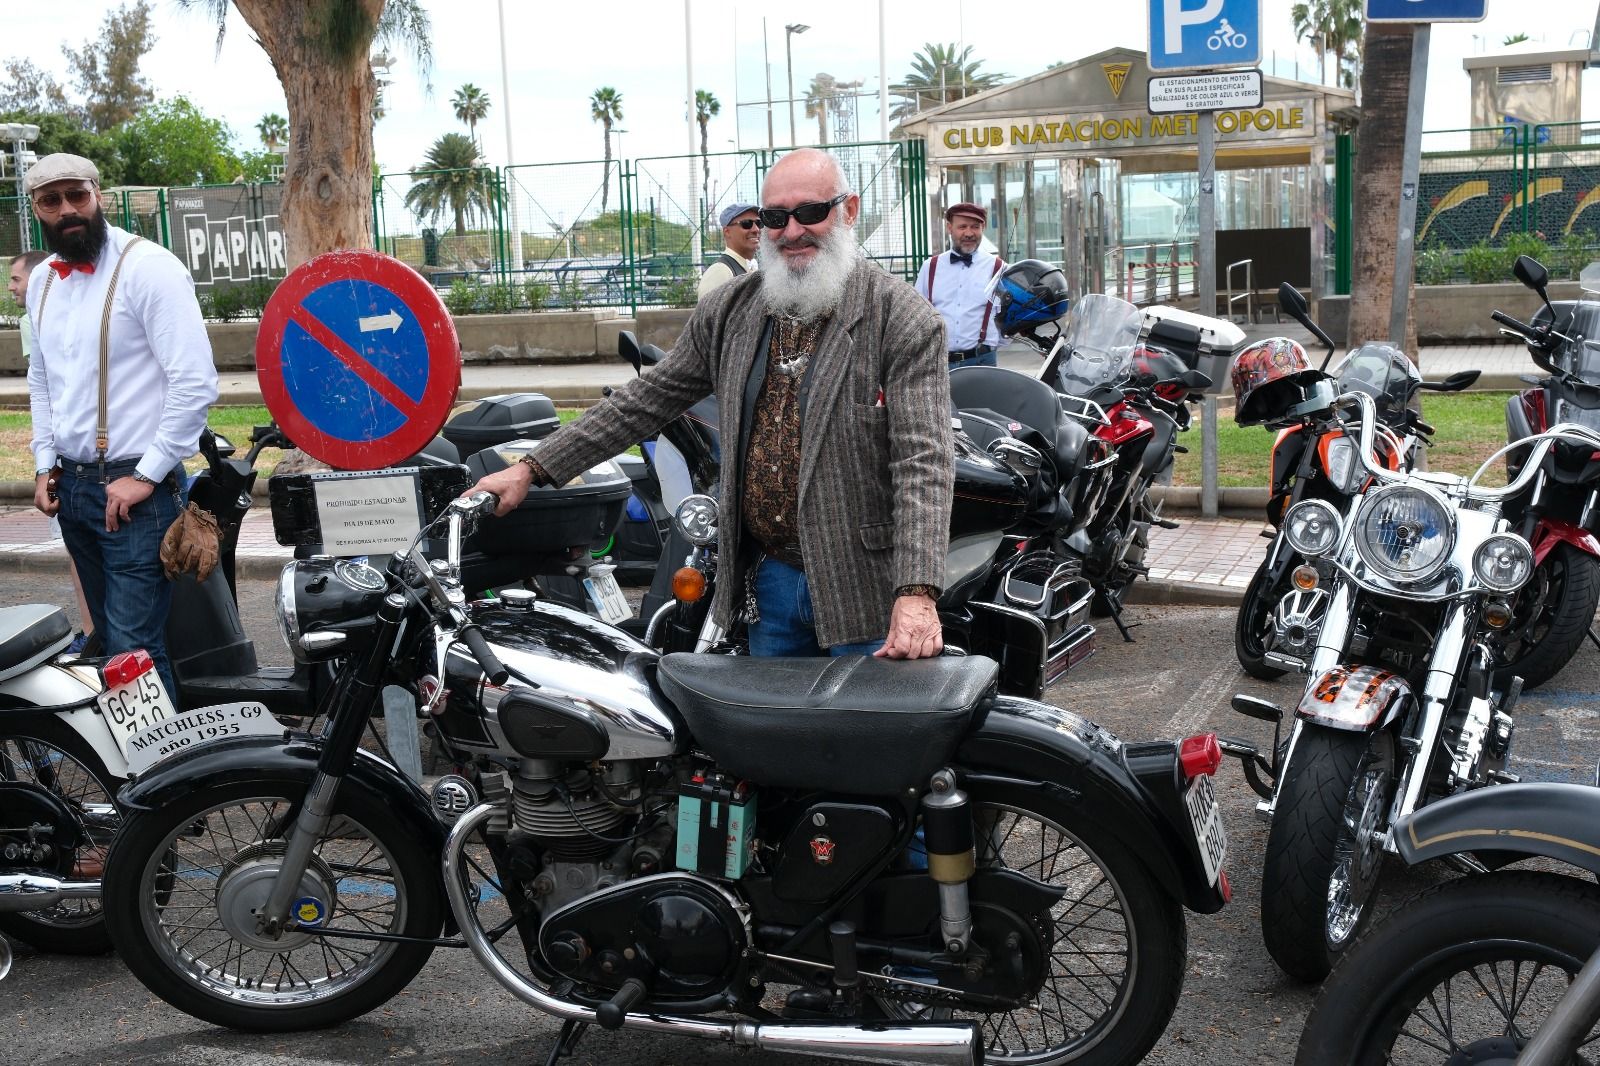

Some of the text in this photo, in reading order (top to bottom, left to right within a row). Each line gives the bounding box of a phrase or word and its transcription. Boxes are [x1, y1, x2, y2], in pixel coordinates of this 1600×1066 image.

[1164, 0, 1225, 54] P
[1151, 94, 1188, 102] SEÑALIZADAS
[1167, 77, 1219, 86] ESTACIONAMIENTO
[943, 107, 1303, 149] CLUB NATACION METOPOLE
[364, 496, 407, 505] ESTACIONAR
[375, 518, 395, 526] MAYO
[107, 671, 160, 725] GC-45
[131, 709, 225, 752] MATCHLESS
[240, 705, 261, 719] G9
[159, 722, 240, 755] año 1955
[1206, 815, 1224, 873] BBC
